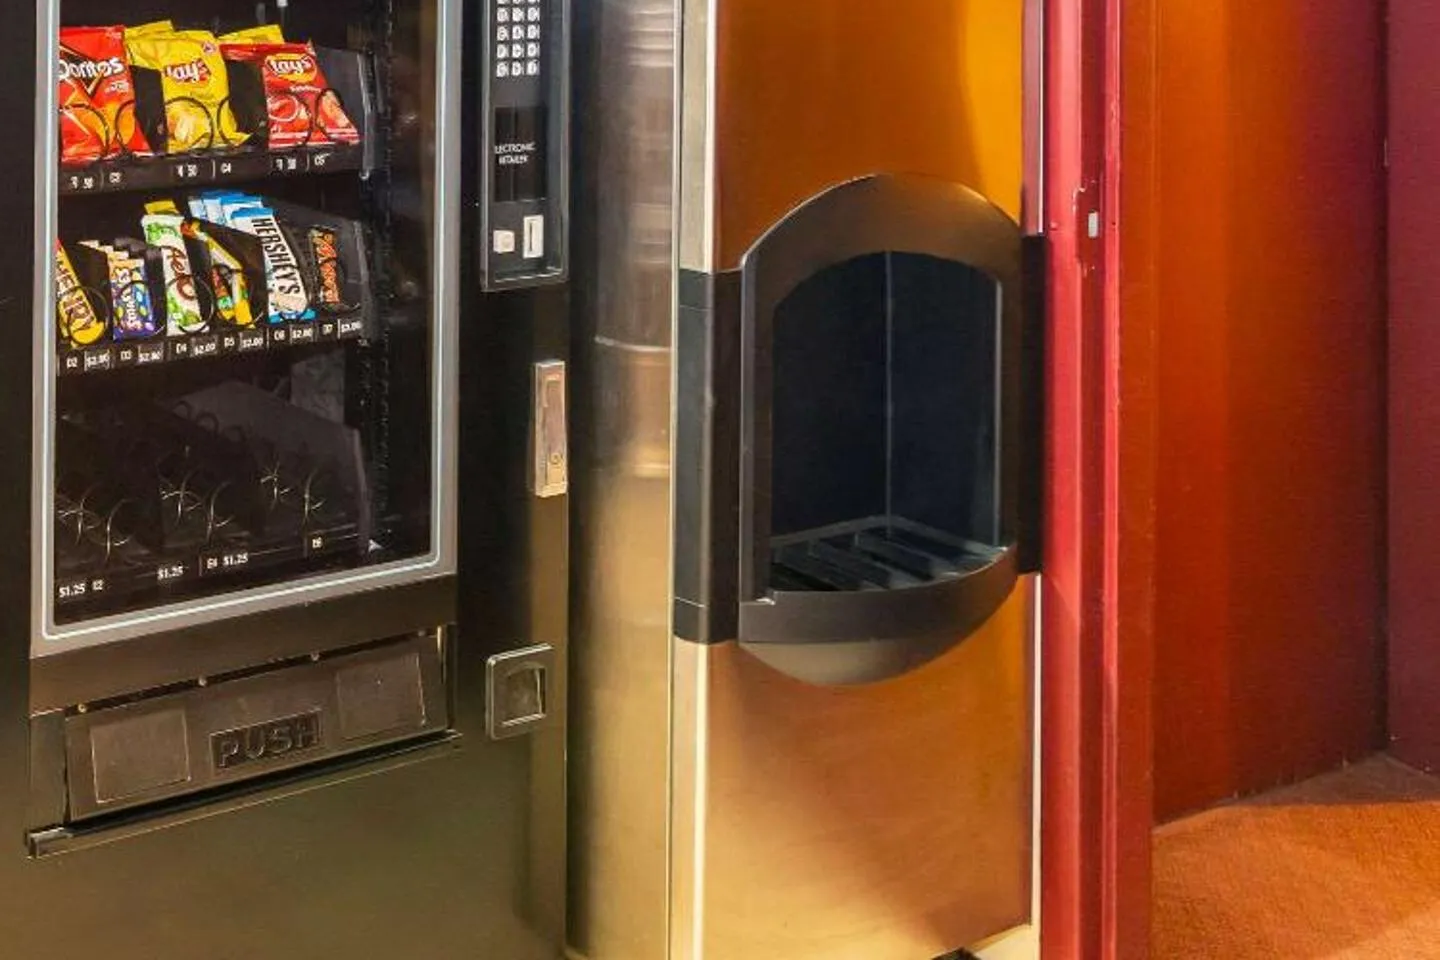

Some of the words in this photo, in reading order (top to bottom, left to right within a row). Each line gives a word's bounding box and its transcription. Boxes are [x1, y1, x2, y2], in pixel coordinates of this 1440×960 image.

[58, 57, 125, 80] Doritos
[251, 217, 302, 296] HERSHEY'S
[223, 552, 249, 567] $1.25
[59, 582, 86, 598] $1.25
[218, 713, 321, 767] PUSH
